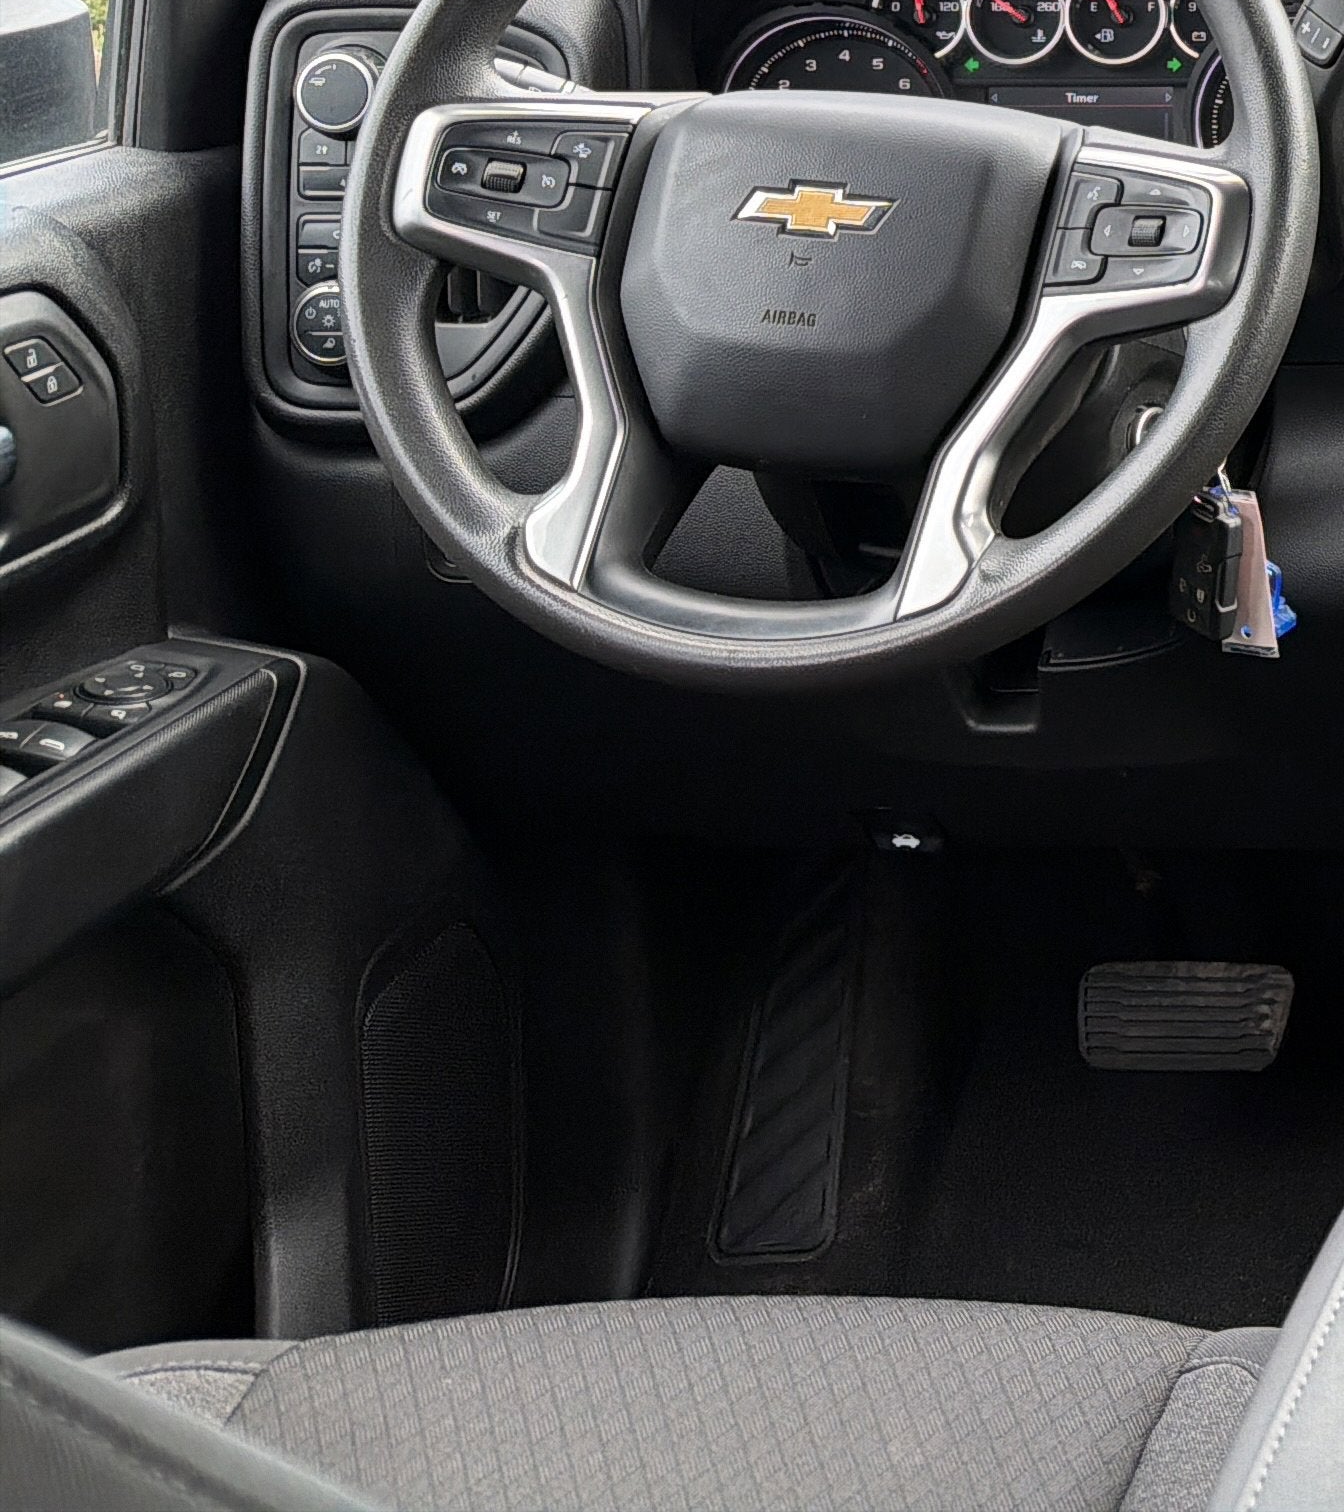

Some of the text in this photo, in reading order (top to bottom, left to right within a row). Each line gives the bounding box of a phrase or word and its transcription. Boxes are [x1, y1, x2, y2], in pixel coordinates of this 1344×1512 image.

[891, 2, 900, 12] 0
[939, 2, 960, 12] 120
[1036, 2, 1060, 12] 260
[1090, 2, 1098, 12] E
[1147, 2, 1156, 12] F
[838, 49, 850, 61] 4
[805, 59, 817, 71] 3
[872, 58, 884, 70] 5
[898, 78, 911, 90] 6
[1065, 92, 1099, 104] Timer
[486, 211, 501, 221] SET
[761, 309, 817, 328] AIRBAG
